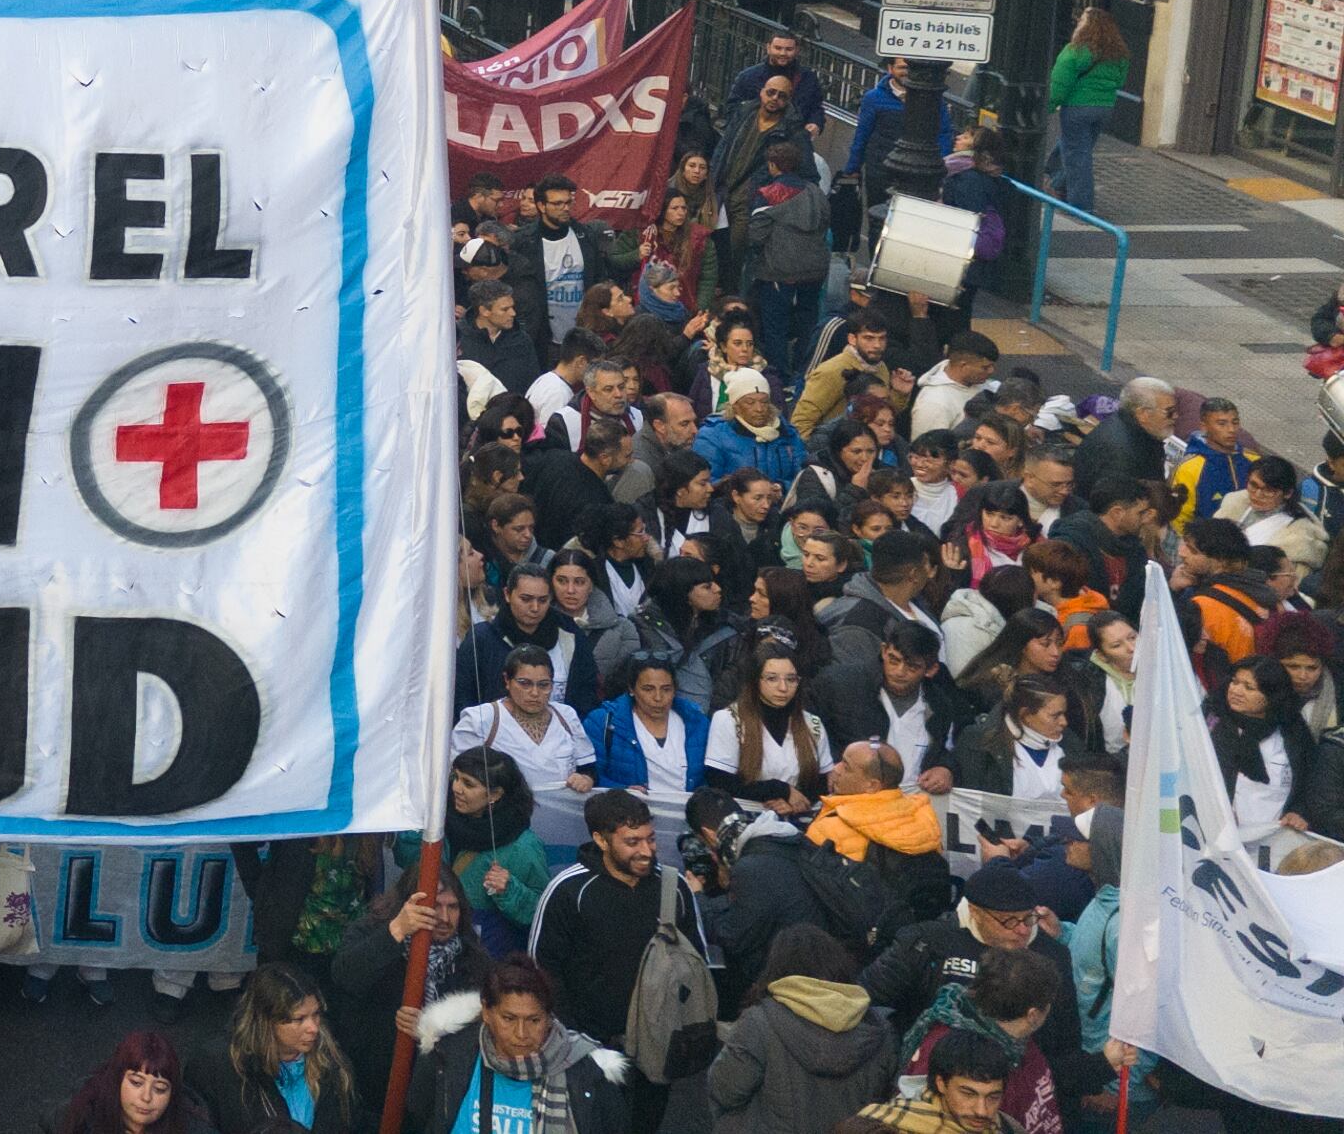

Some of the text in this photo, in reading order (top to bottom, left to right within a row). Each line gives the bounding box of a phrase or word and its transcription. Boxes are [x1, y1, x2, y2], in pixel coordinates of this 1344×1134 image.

[889, 18, 982, 36] Días hábiles
[886, 35, 980, 53] de 7 a 21 hs.
[90, 151, 255, 282] EL
